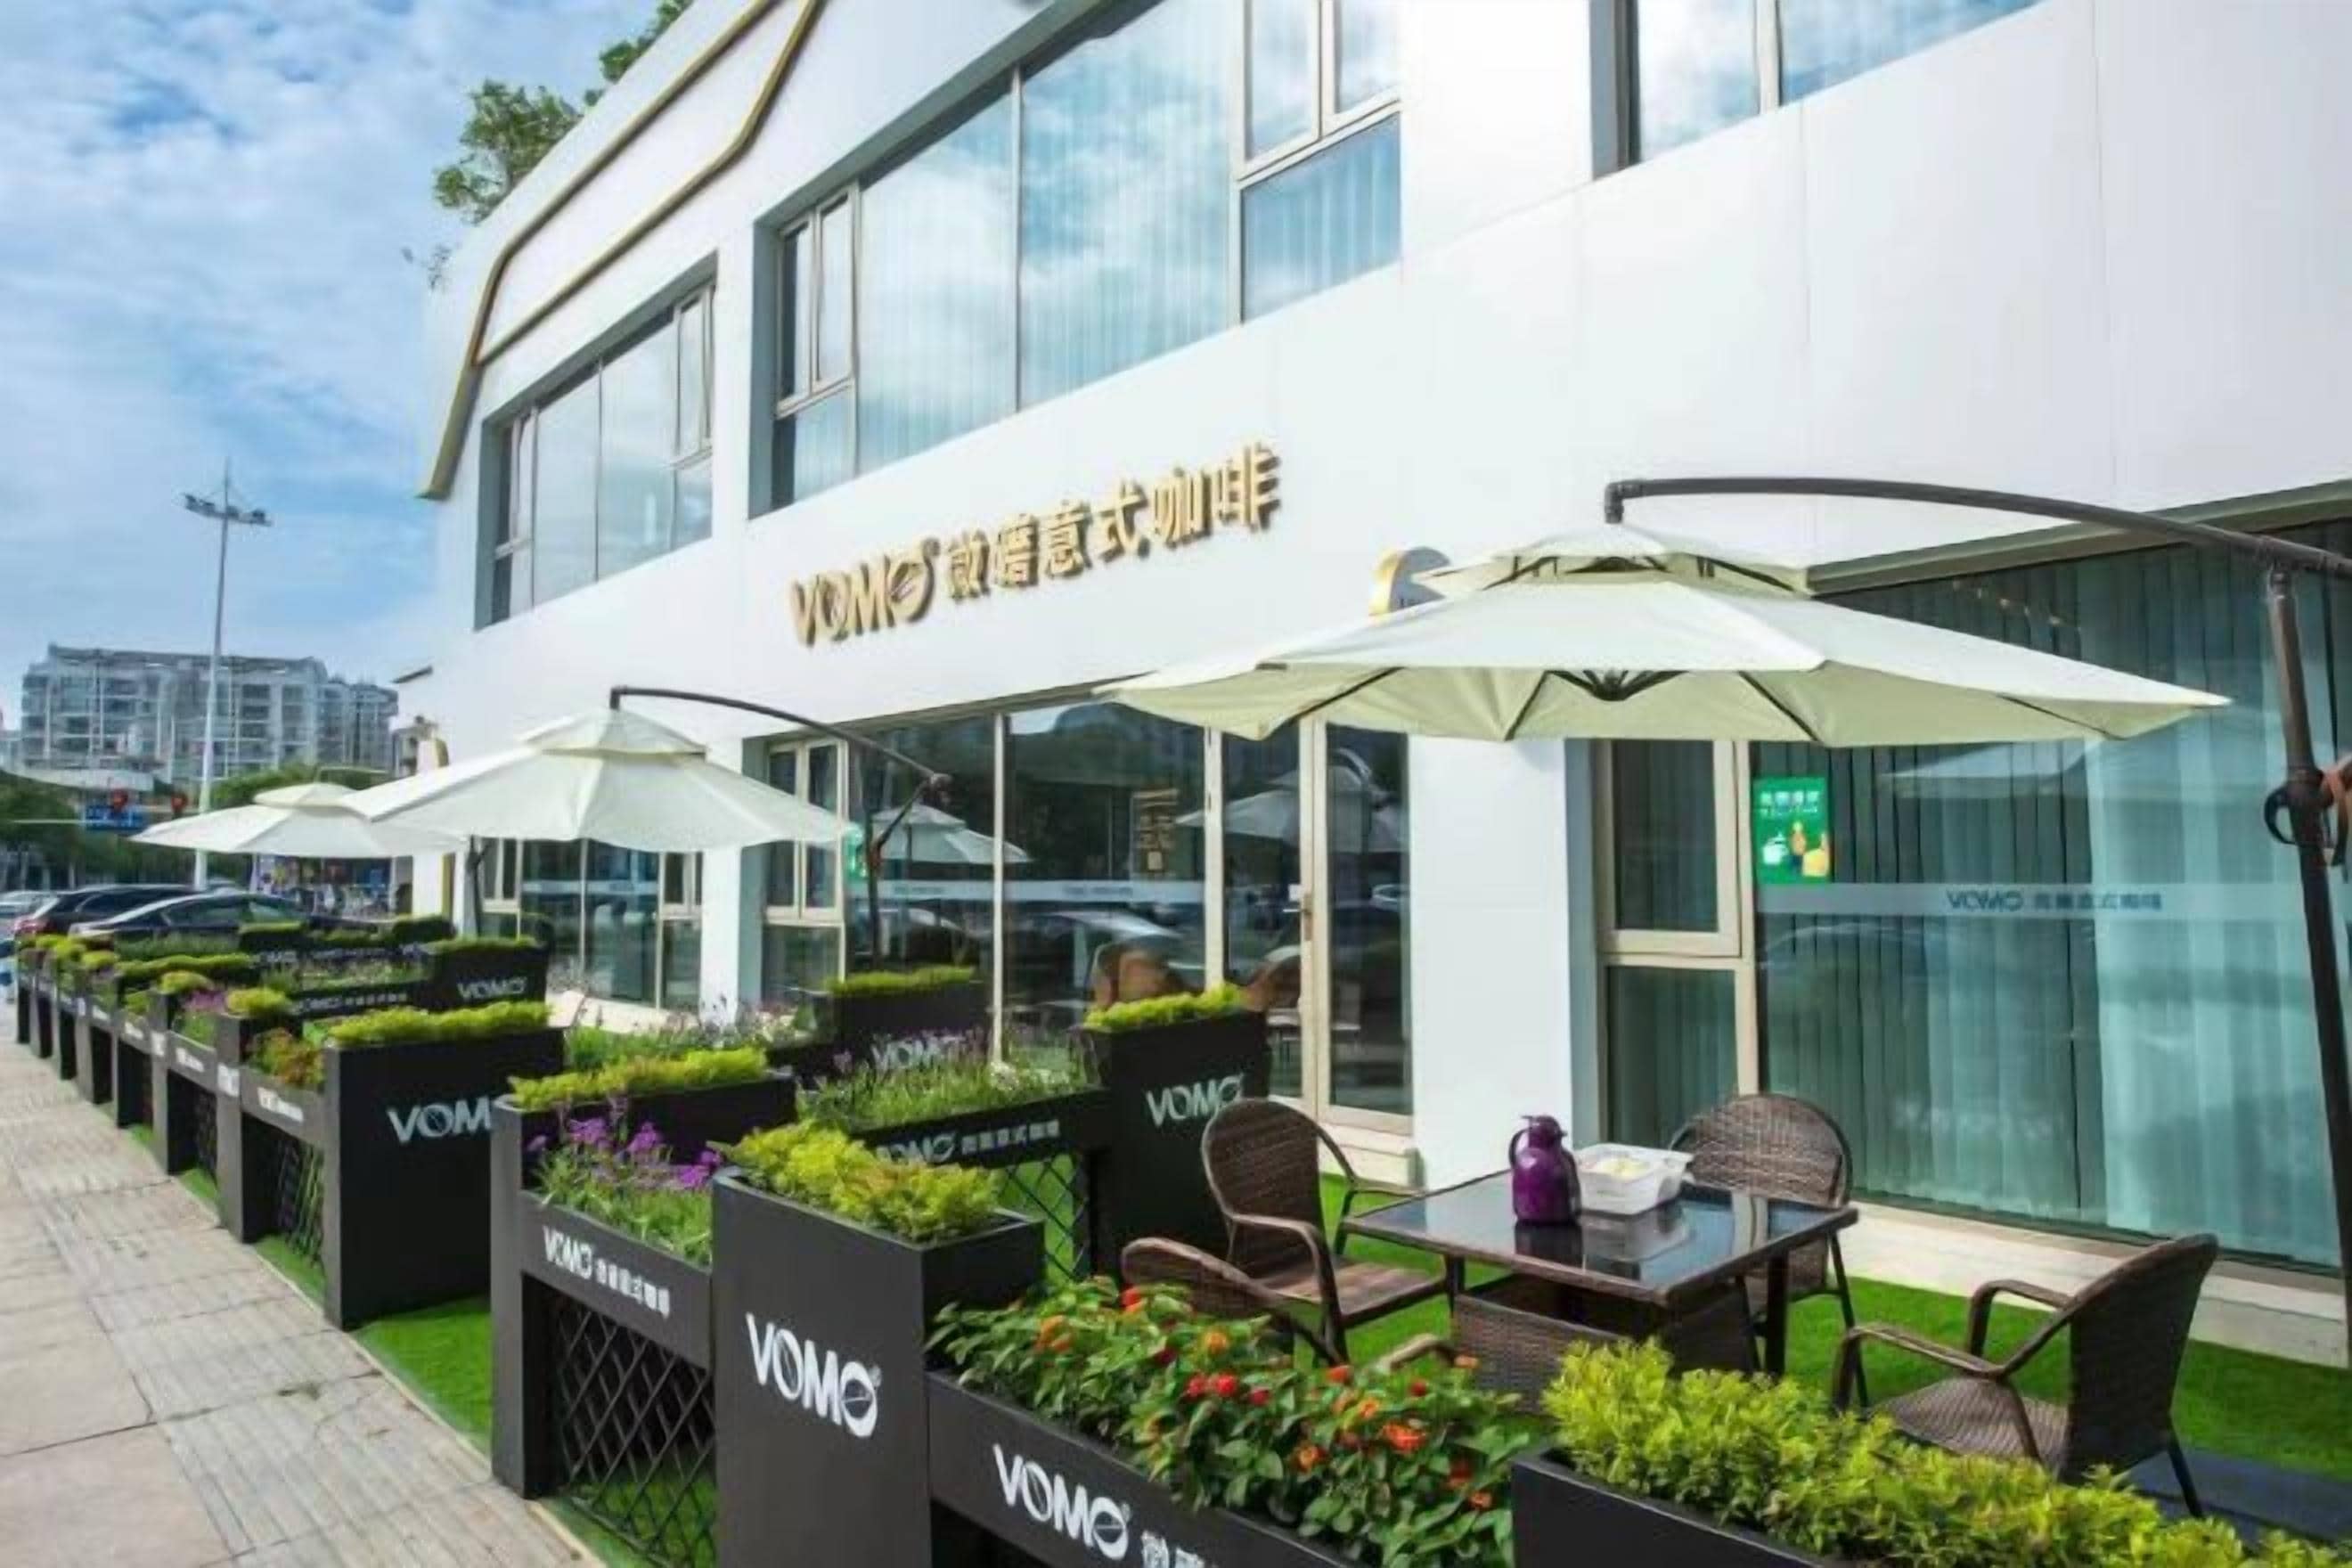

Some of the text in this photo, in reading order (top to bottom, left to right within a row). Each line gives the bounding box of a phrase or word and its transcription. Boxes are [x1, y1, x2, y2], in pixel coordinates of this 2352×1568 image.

[789, 539, 939, 648] VOMO
[388, 1096, 492, 1145] VOM
[746, 1312, 882, 1438] VOMO
[994, 1443, 1130, 1560] VOMO
